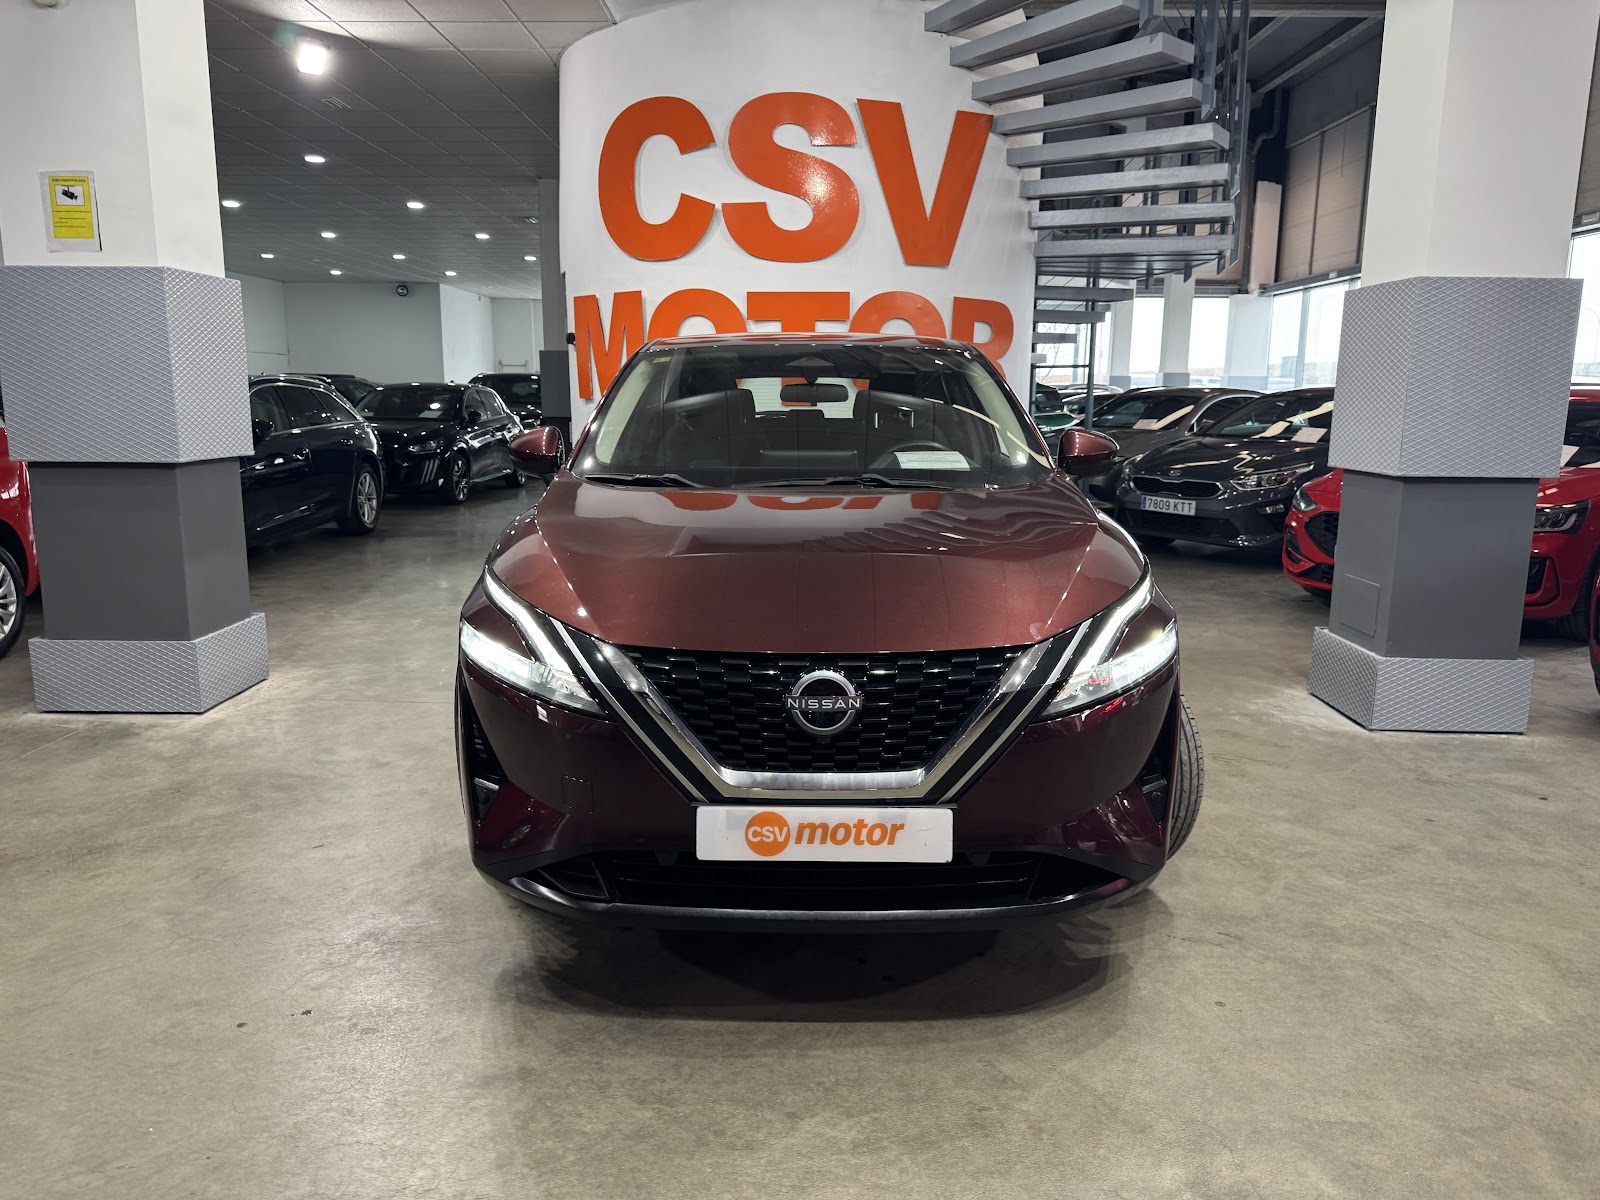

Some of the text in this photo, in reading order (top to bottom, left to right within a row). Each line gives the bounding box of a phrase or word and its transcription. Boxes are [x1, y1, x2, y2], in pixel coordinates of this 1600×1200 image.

[598, 92, 993, 266] CSV
[1147, 498, 1193, 513] 7809 KTT
[787, 698, 860, 709] NISSAN
[747, 818, 905, 846] CSV motor
